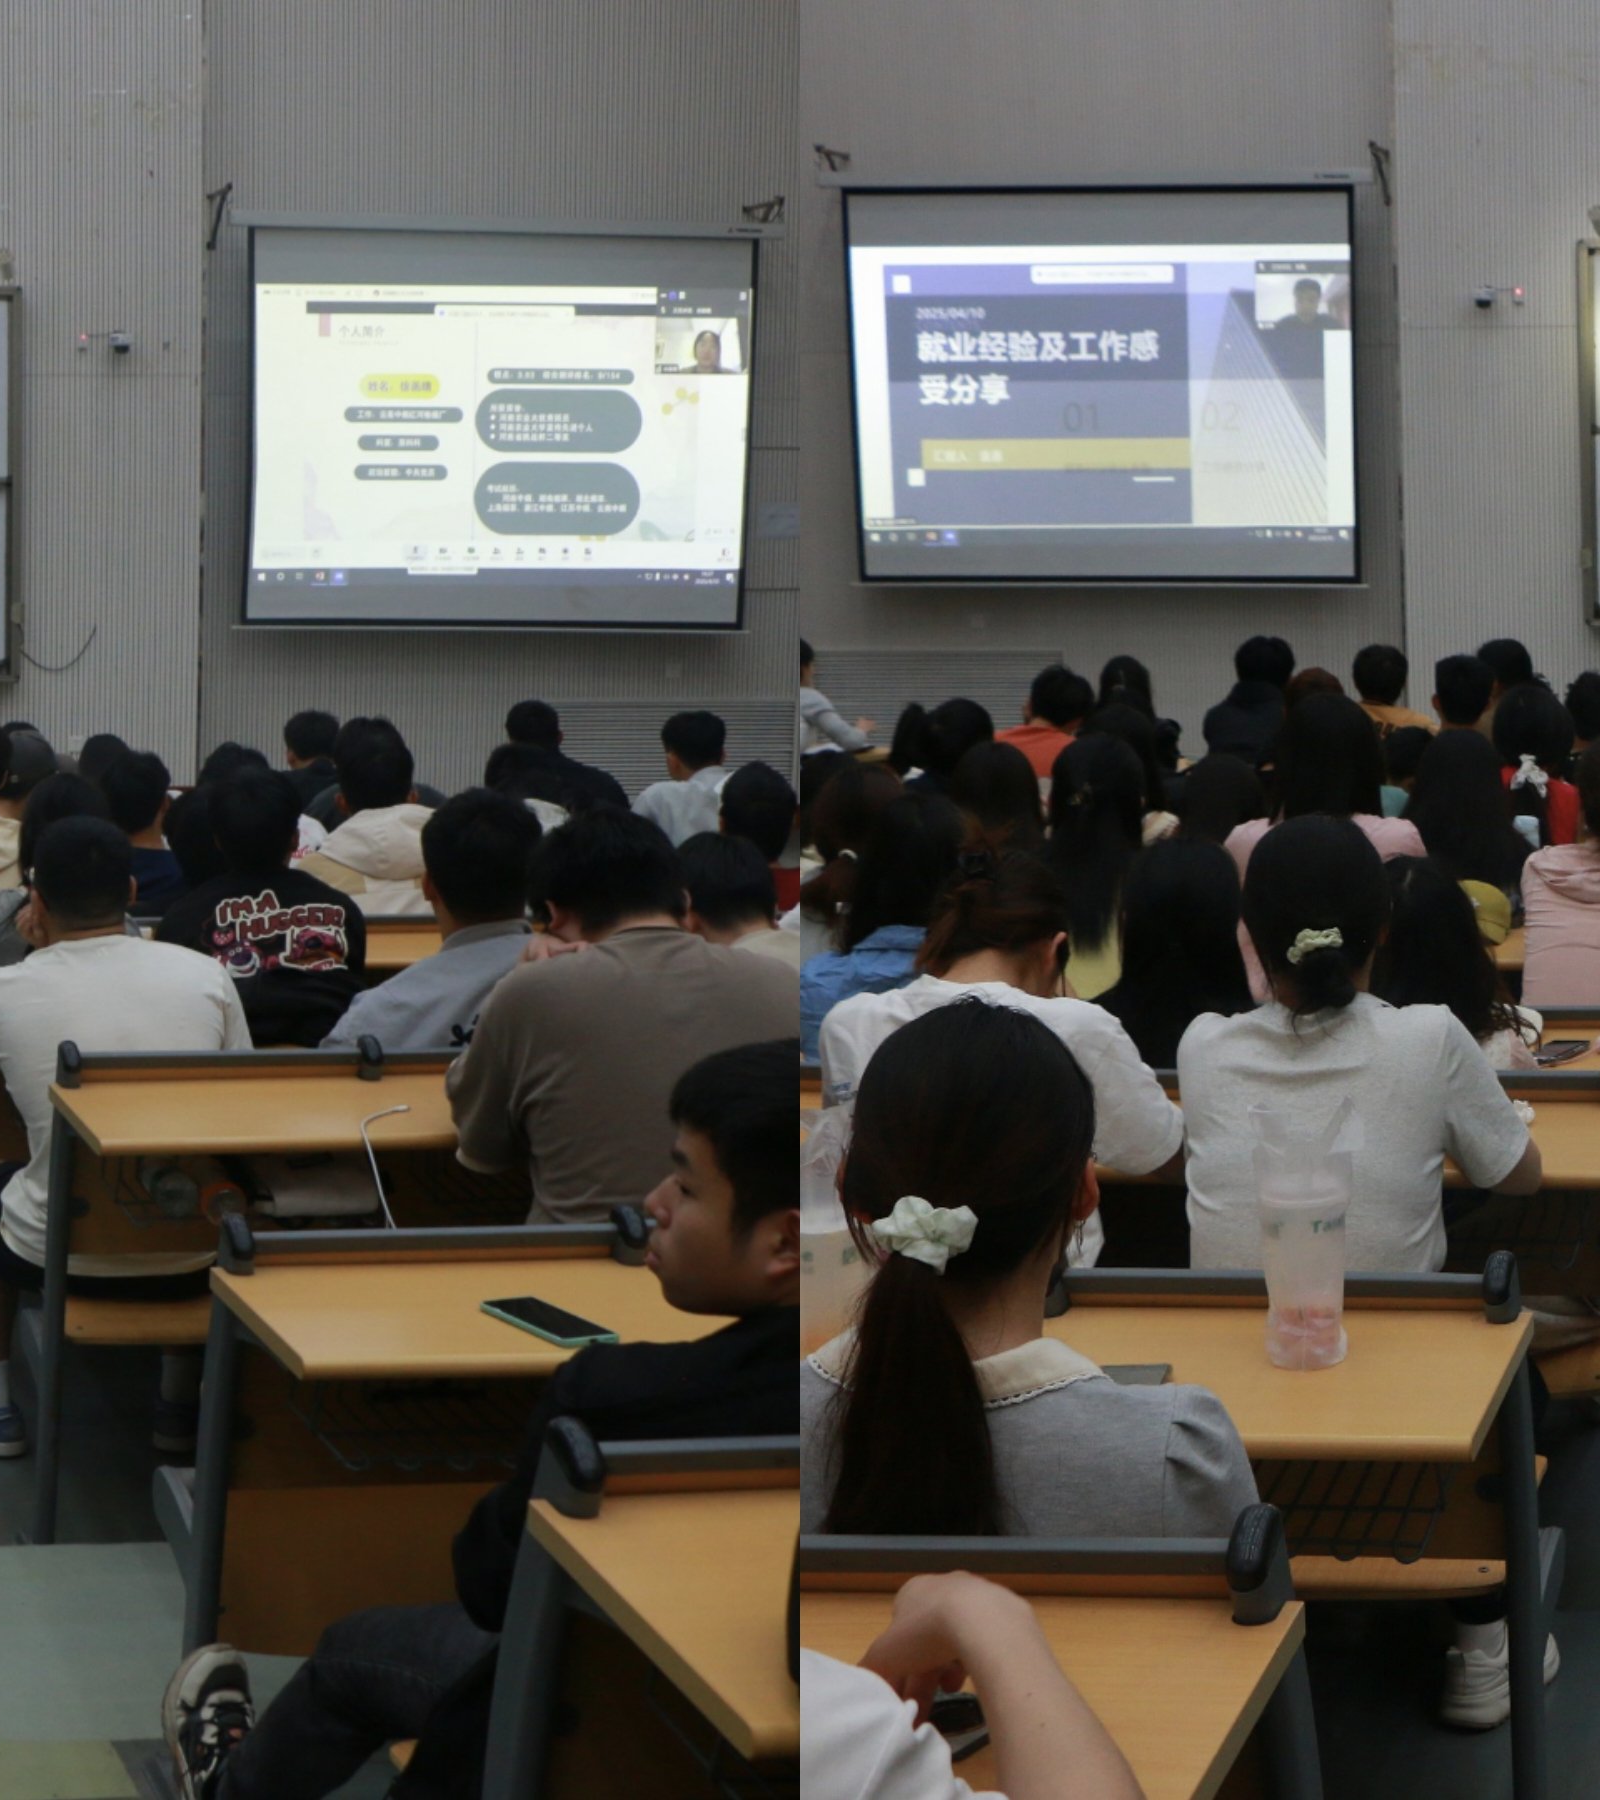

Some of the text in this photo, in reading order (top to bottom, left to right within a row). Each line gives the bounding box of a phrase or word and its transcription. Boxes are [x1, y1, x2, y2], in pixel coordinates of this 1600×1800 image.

[916, 307, 986, 320] 2025/04/10
[339, 325, 385, 339] 个人简介
[917, 330, 1160, 363] 就业经验及工作感
[919, 373, 1011, 405] 受分享
[1062, 402, 1100, 433] 01
[216, 888, 280, 926] I'M A
